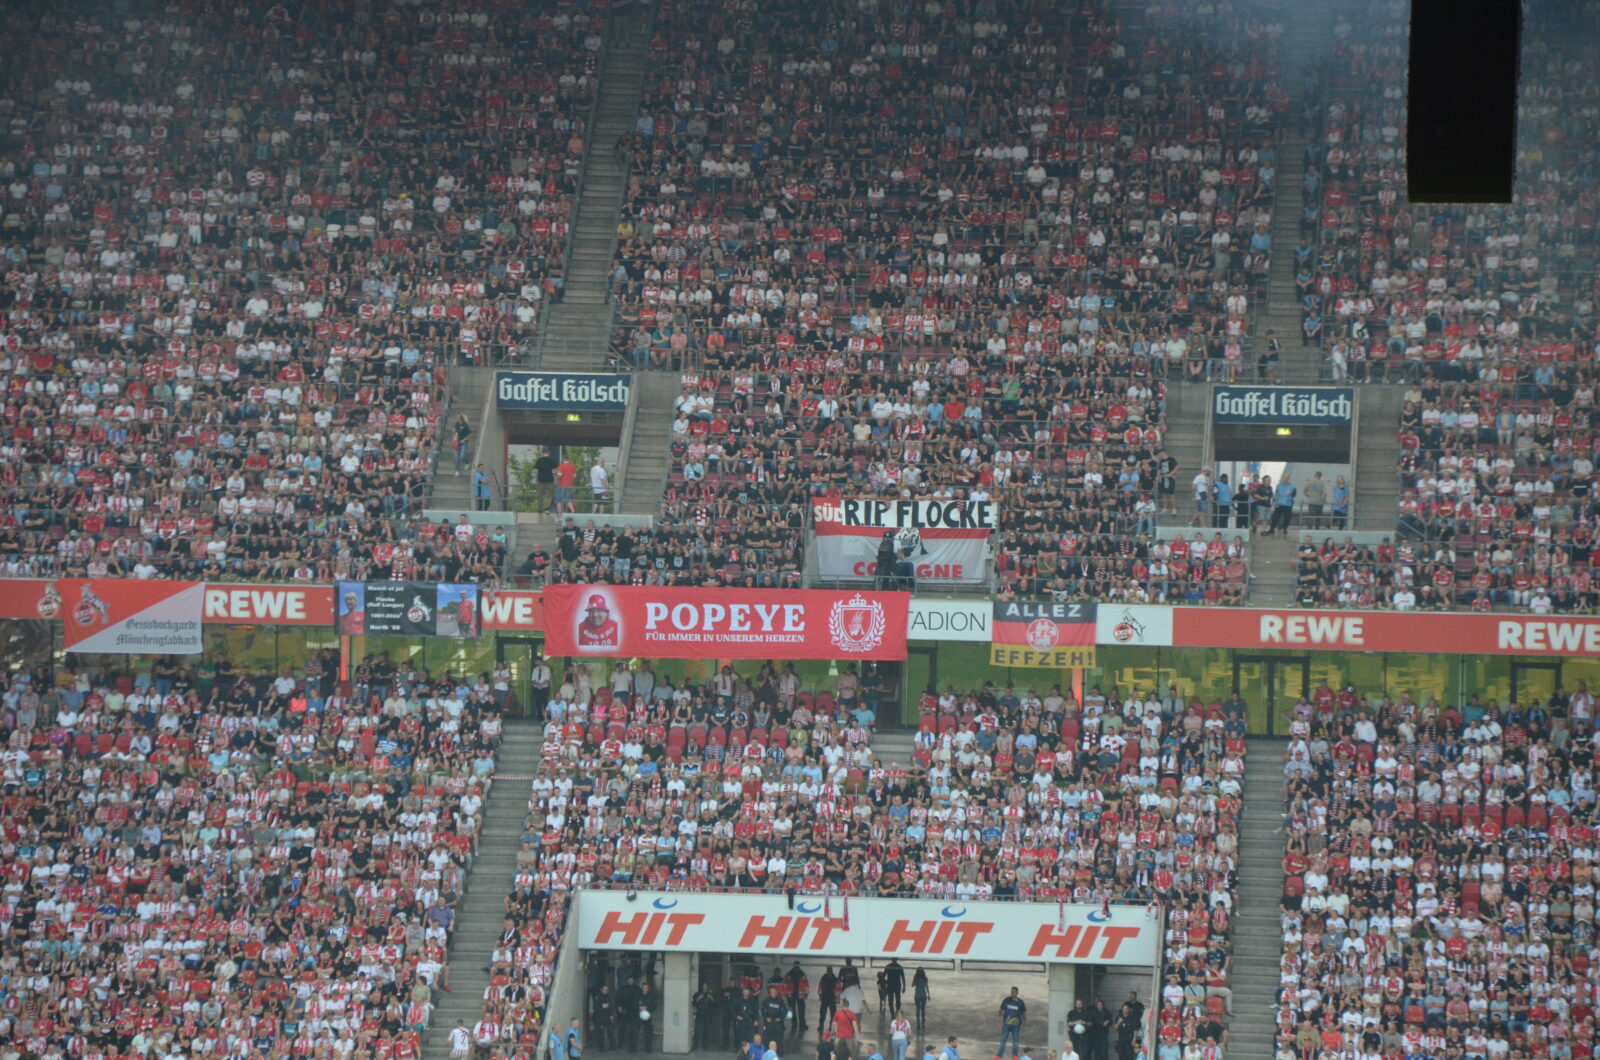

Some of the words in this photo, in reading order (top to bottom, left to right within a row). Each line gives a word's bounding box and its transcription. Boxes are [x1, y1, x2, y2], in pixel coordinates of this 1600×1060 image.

[499, 377, 559, 403] Gaffel
[562, 379, 630, 406] Kölsch
[1216, 391, 1278, 417] Gaffel
[1281, 392, 1352, 420] Kölsch
[897, 500, 992, 528] FLOCKE
[853, 561, 964, 578] COGNE
[205, 590, 307, 619] REWE
[645, 602, 805, 632] POPEYE
[1005, 602, 1081, 618] ALLEZ
[115, 634, 197, 647] Mönchengladbach
[645, 631, 666, 641] FÜR
[667, 633, 701, 642] IMMER
[703, 633, 714, 642] IN
[716, 634, 764, 643] UNSEREM
[765, 634, 805, 643] HERZEN
[1260, 614, 1364, 645] REWE
[1498, 621, 1600, 651] REWE
[994, 648, 1093, 666] EFFZEH!
[594, 912, 706, 945] HIT
[737, 915, 848, 950] HIT
[882, 920, 995, 955] HIT
[1027, 924, 1141, 959] HIT
